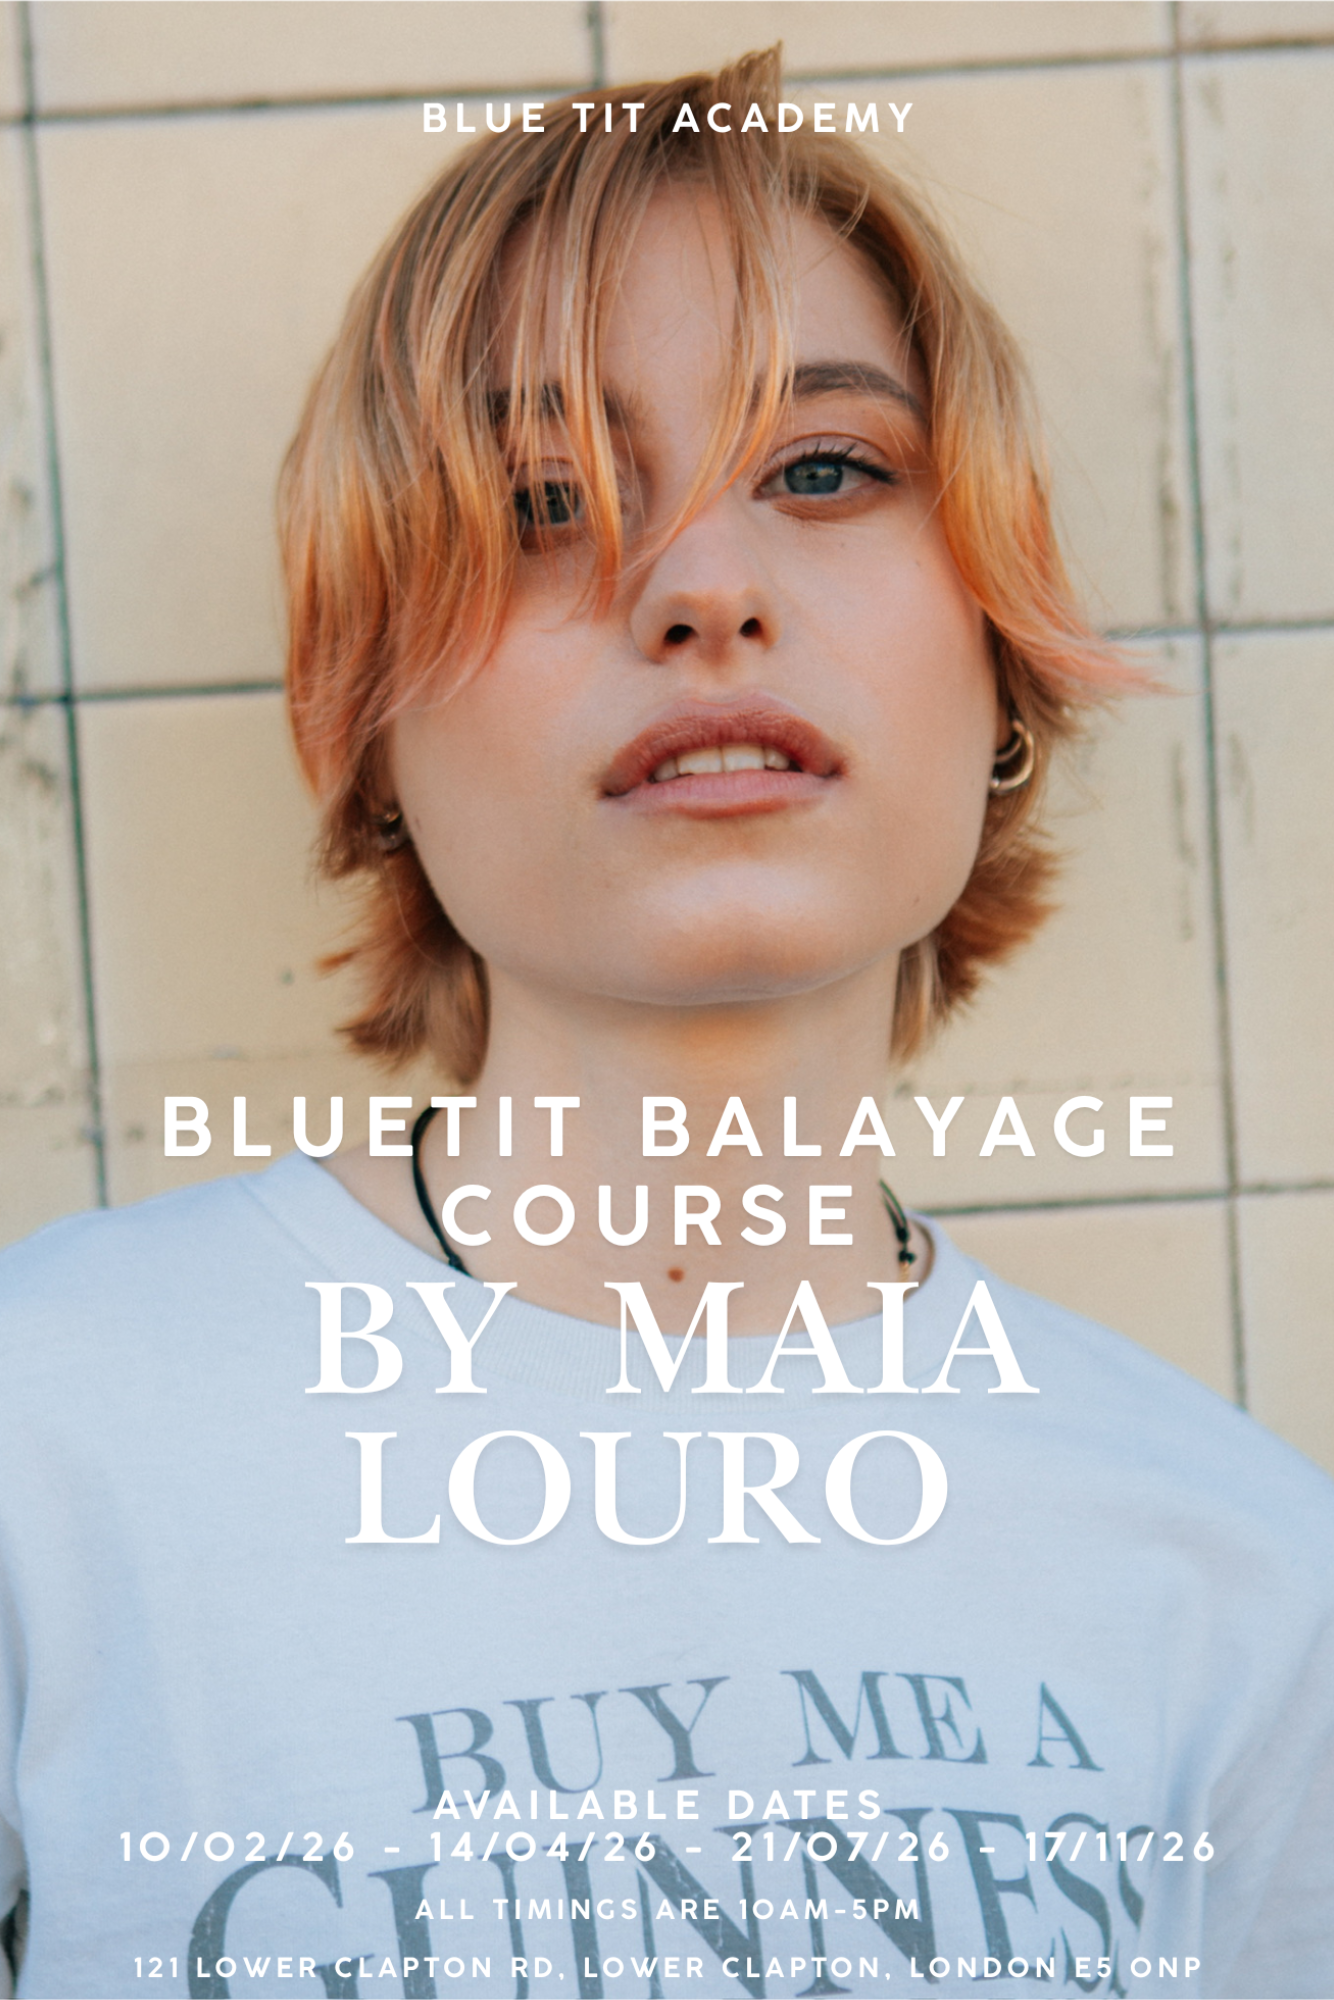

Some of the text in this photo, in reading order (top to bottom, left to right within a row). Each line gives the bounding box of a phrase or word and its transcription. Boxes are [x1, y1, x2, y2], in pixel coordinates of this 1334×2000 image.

[395, 1669, 1105, 1814] BUY ME A
